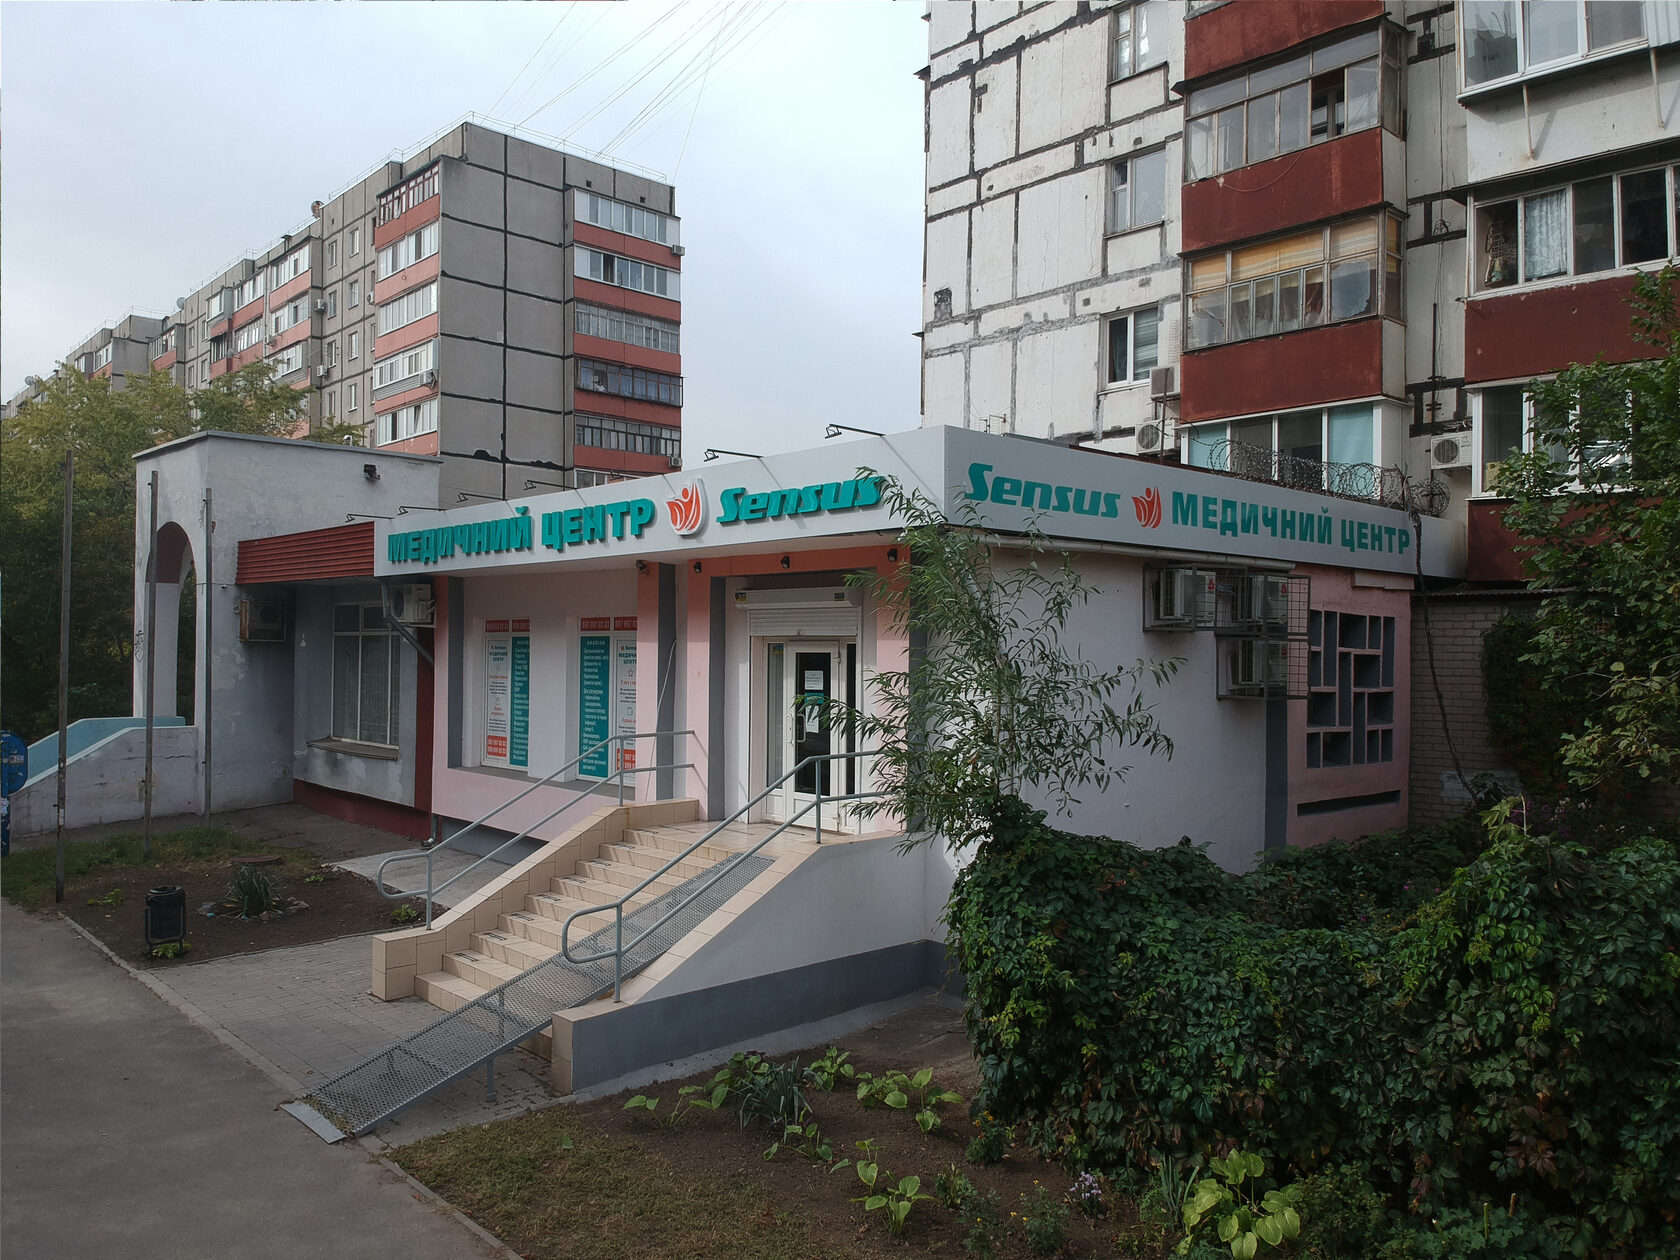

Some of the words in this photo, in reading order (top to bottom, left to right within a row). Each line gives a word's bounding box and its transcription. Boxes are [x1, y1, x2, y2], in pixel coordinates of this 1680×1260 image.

[716, 475, 886, 524] Sensus
[965, 463, 1120, 518] Sensus
[388, 507, 532, 563] МЕДИЧНИЙ
[541, 498, 655, 551] ЦЕНТР
[1172, 492, 1332, 544] МЕДИЧНИЙ
[1341, 519, 1410, 554] ЦЕНТР
